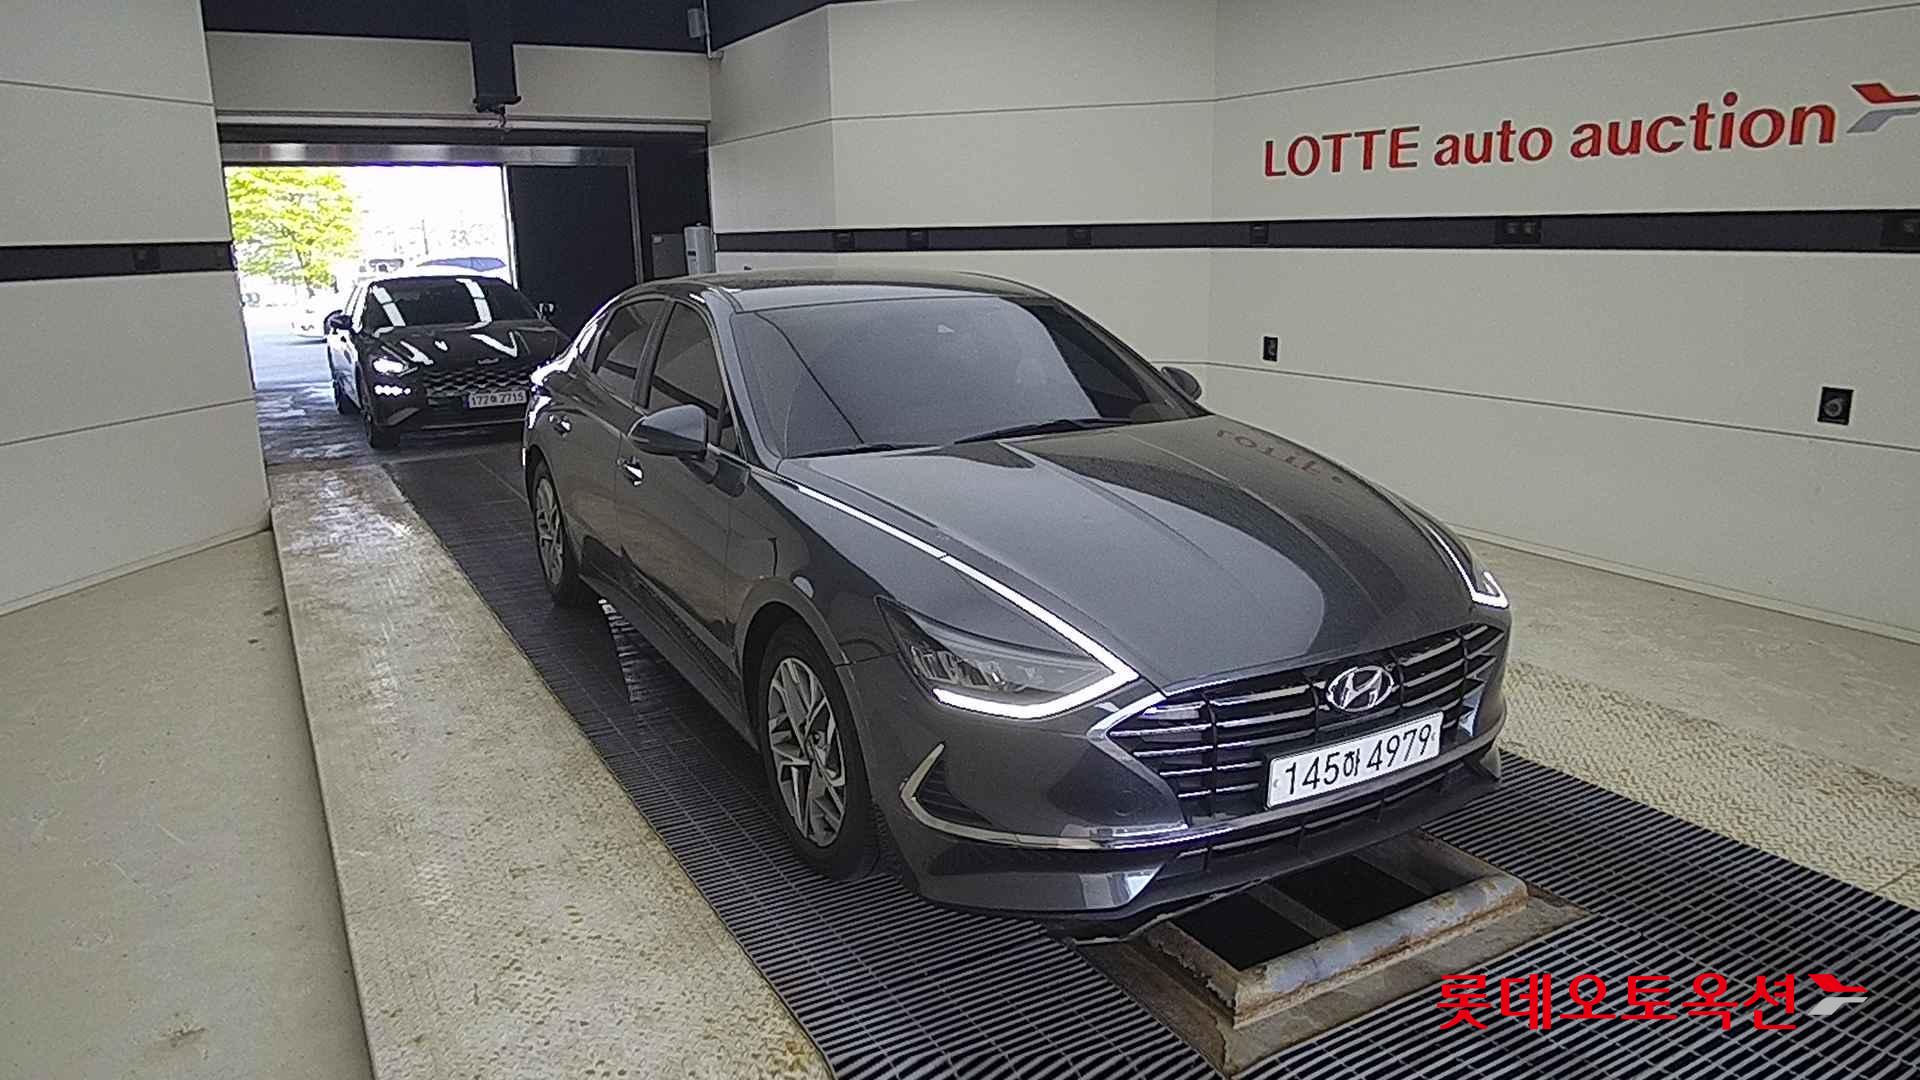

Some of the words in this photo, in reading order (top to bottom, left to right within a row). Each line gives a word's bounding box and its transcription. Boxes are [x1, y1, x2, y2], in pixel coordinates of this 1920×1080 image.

[1264, 126, 1420, 177] LOTTE
[1434, 120, 1553, 168] auto
[1570, 92, 1836, 159] auction
[1285, 748, 1360, 795] 145하
[1366, 723, 1432, 771] 4979
